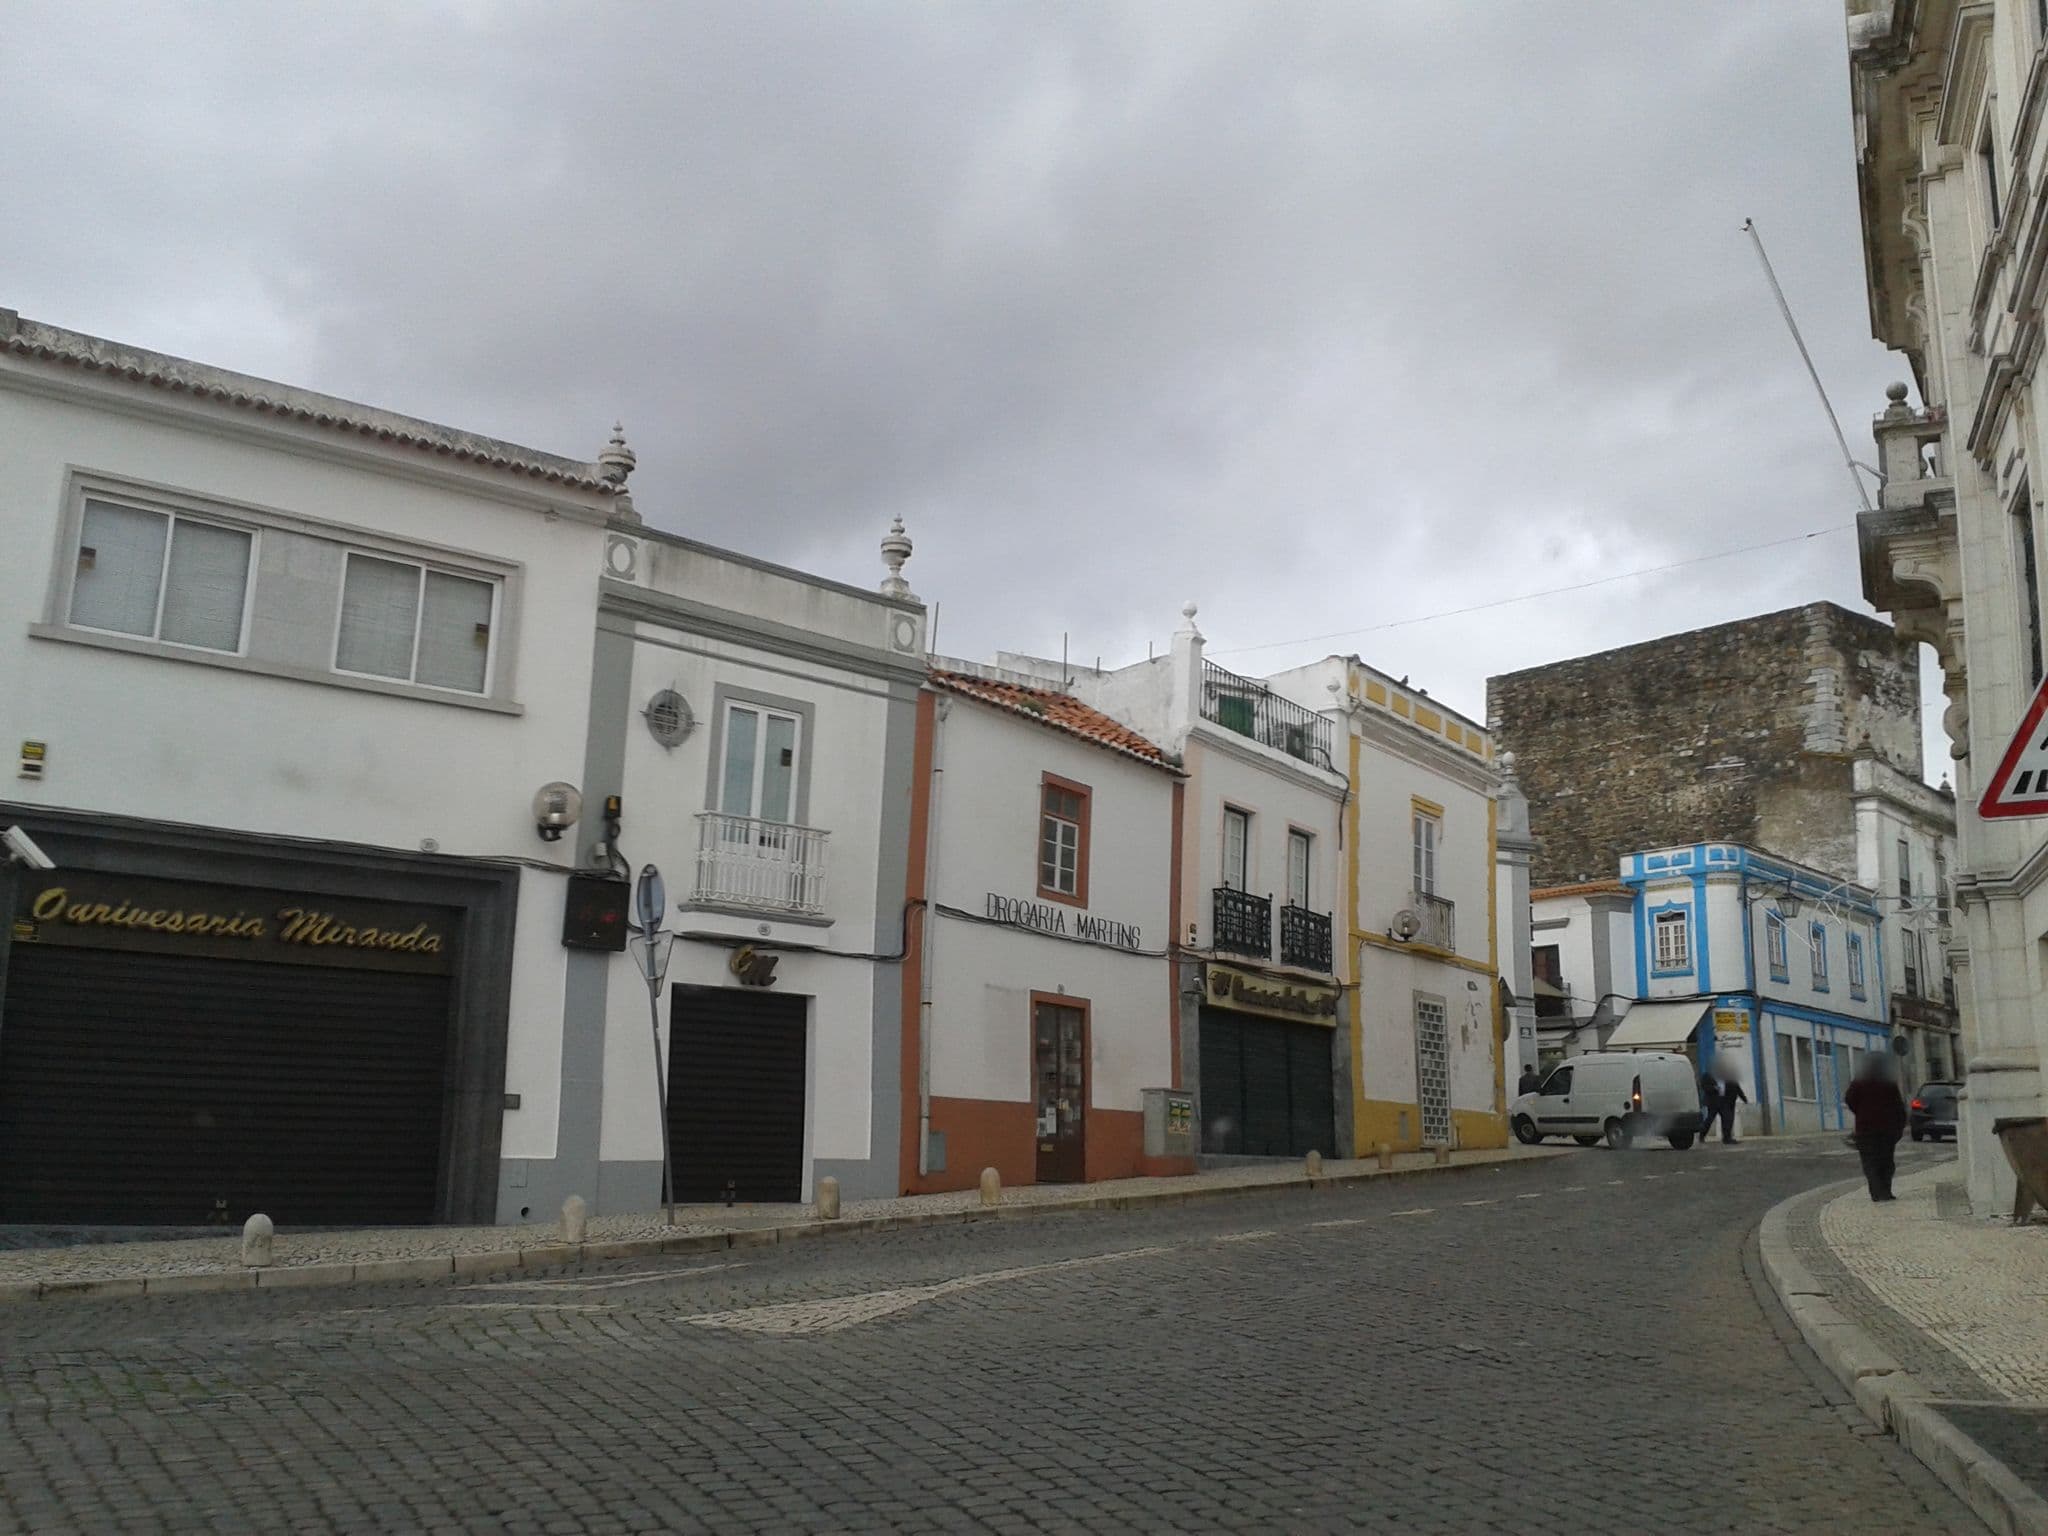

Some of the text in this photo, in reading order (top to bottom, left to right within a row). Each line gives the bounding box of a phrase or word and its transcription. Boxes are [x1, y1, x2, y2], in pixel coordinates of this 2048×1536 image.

[33, 887, 266, 936] Ourivesaria
[277, 907, 441, 952] Miranda
[986, 892, 1141, 949] DROGARIA MARTINS
